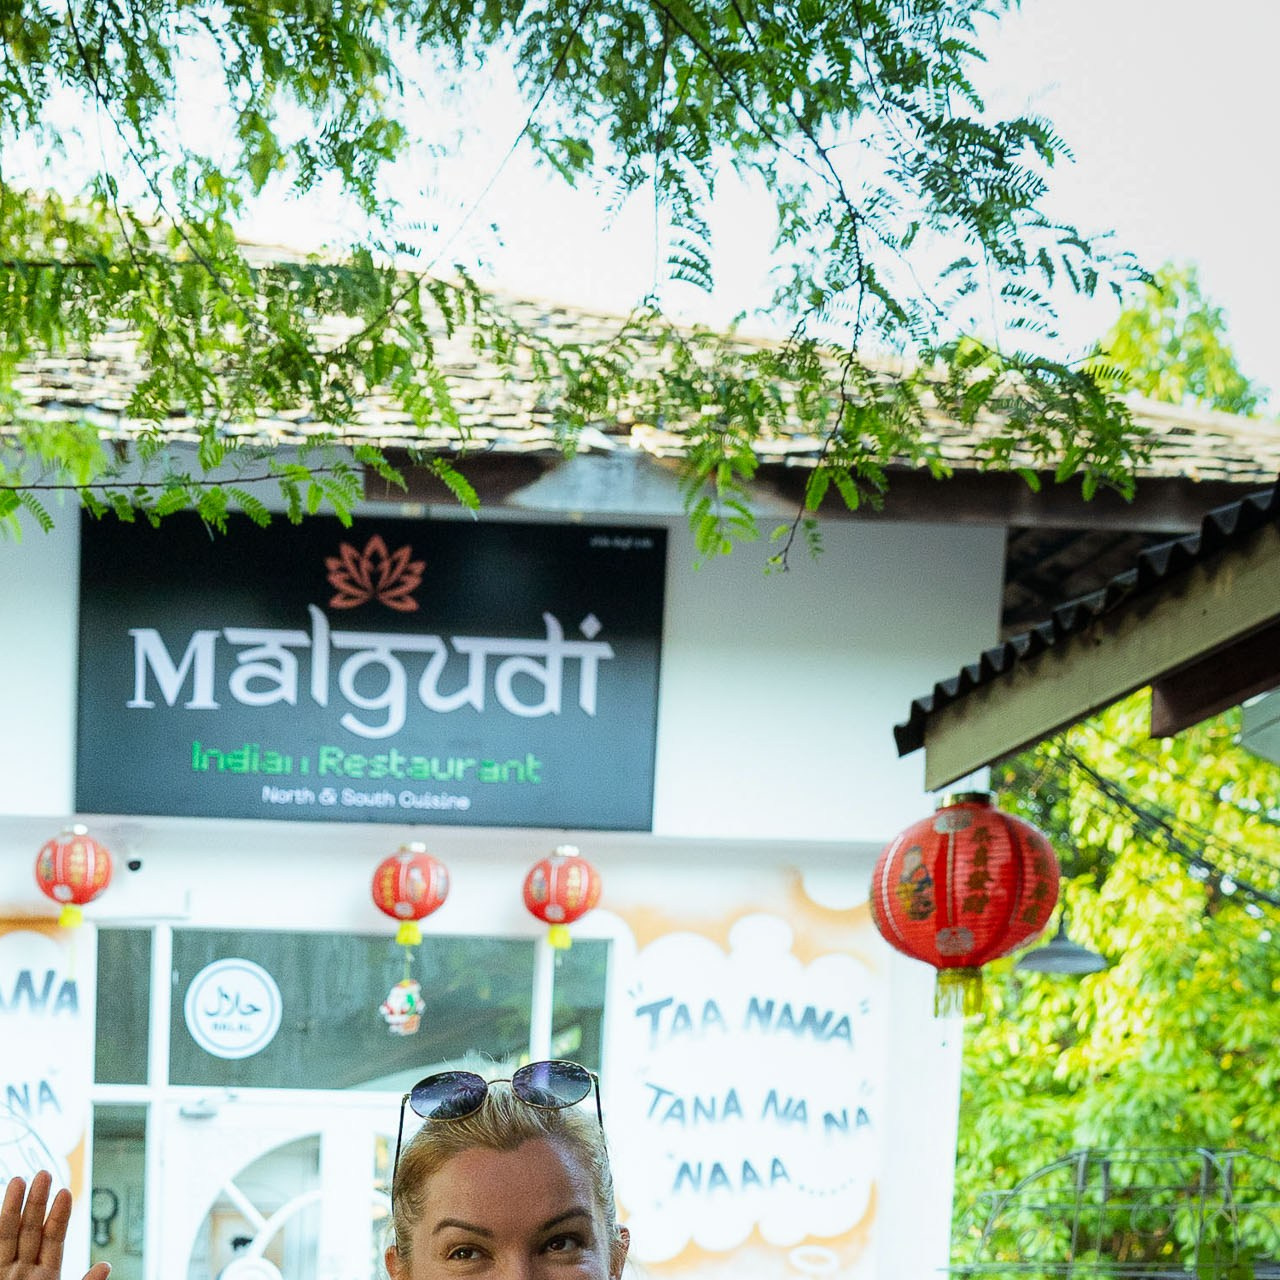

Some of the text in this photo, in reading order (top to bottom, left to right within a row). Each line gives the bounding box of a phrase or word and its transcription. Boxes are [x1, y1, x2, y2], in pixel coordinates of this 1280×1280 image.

[126, 602, 615, 739] Malgudi
[191, 741, 543, 784] Indian Restaurant
[262, 786, 471, 810] North & South Cuisine
